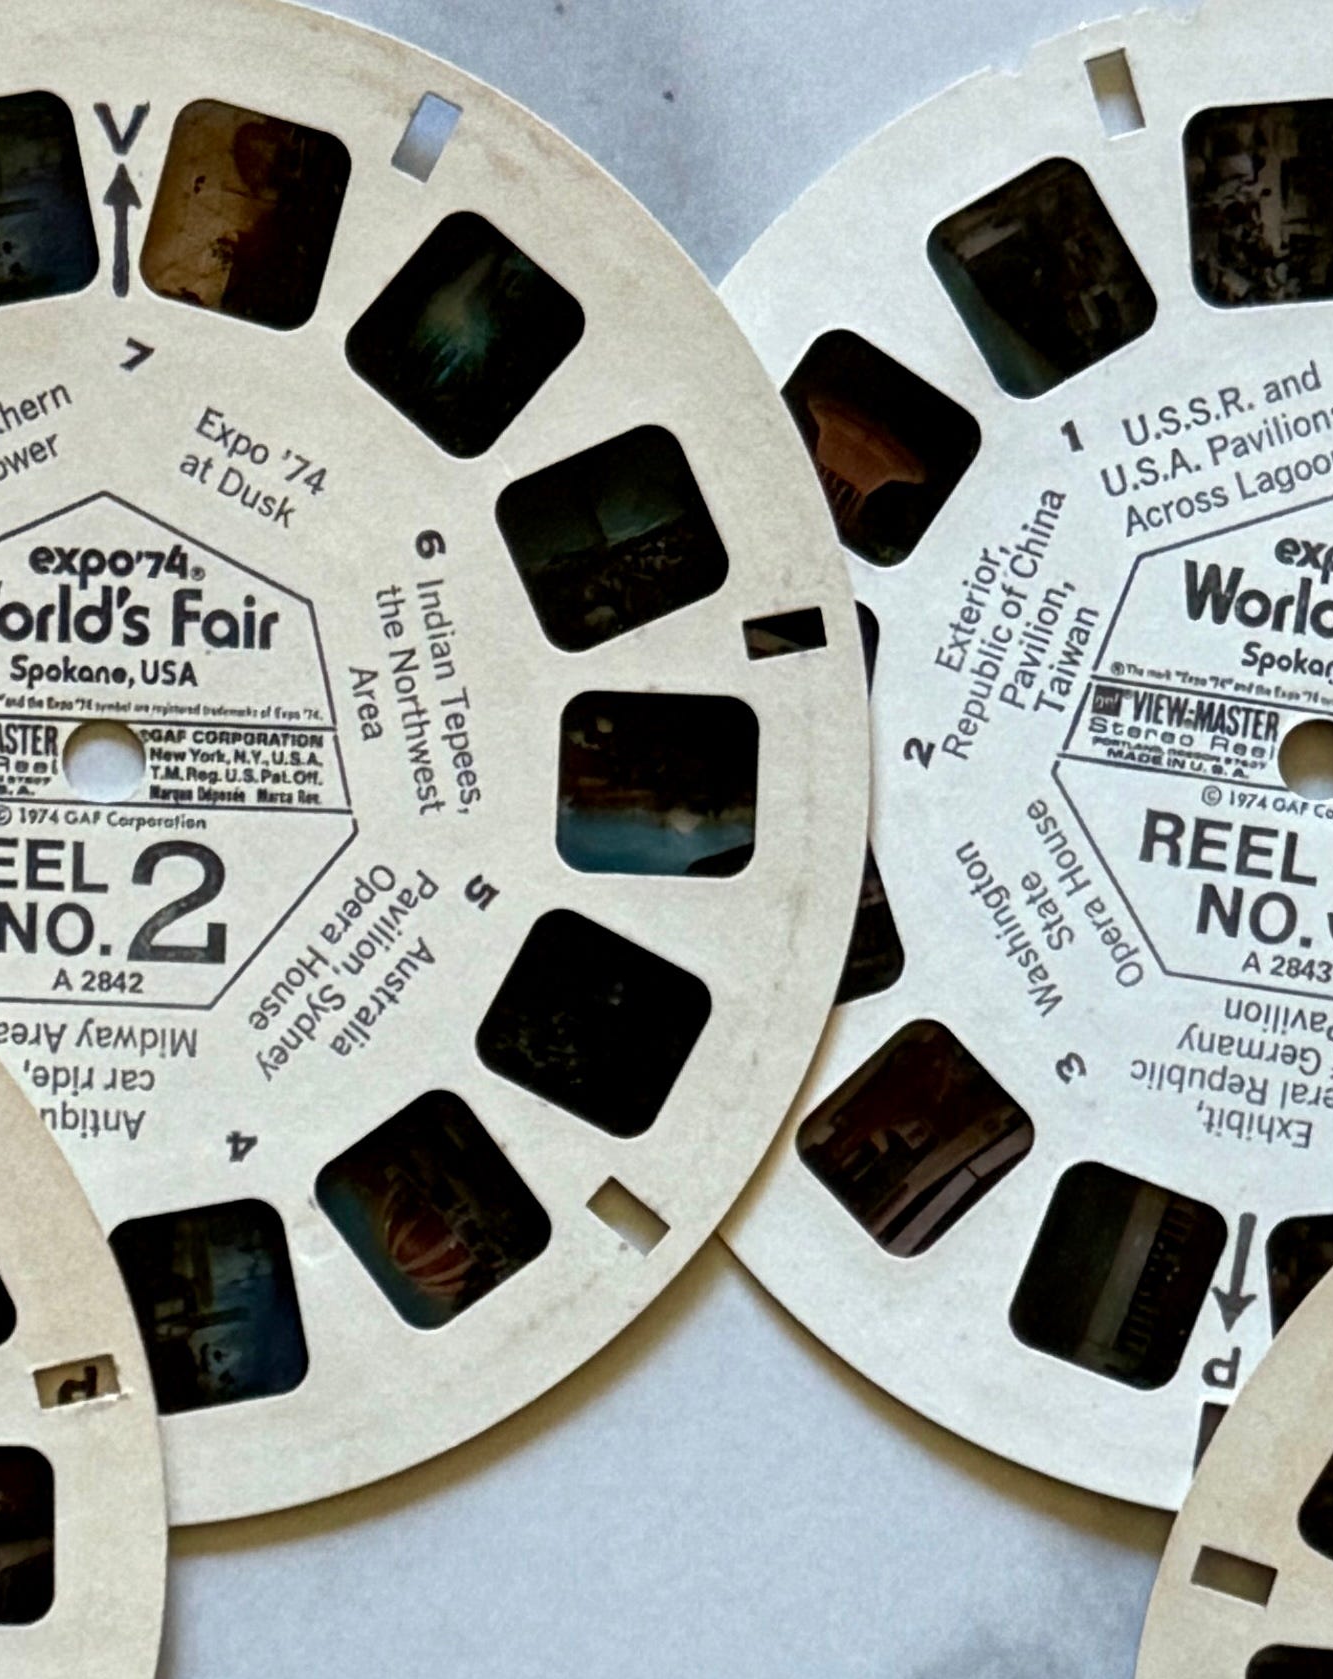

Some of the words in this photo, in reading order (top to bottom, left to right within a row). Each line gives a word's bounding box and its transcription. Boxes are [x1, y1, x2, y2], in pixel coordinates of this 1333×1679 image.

[94, 103, 149, 154] V
[1121, 386, 1254, 446] U.S.S.R.
[1263, 359, 1321, 403] and
[195, 405, 269, 465] Expo
[1060, 419, 1084, 452] 1
[179, 453, 213, 484] at
[216, 466, 295, 528] Dusk
[1100, 447, 1201, 496] U.S.A.
[1125, 485, 1229, 537] Across
[171, 588, 278, 649] Fair
[10, 654, 134, 689] Spokane,
[141, 659, 197, 686] USA
[149, 746, 186, 761] New
[188, 747, 231, 765] York,
[151, 728, 186, 743] GAF
[191, 729, 323, 748] CORPORATION
[19, 806, 59, 824] 1974
[63, 810, 100, 824] GAF
[106, 810, 206, 831] Corporation
[1229, 790, 1266, 809] 1974
[1272, 797, 1308, 815] GAF
[1139, 809, 1316, 886] REEL
[127, 839, 226, 963] 2
[319, 864, 395, 944] Opera
[331, 869, 439, 975] Pavilion,
[1197, 883, 1311, 947] NO.
[53, 968, 71, 989] A
[82, 970, 142, 993] 2842
[248, 944, 329, 1030] House
[1242, 952, 1260, 972] A
[1270, 955, 1332, 982] 2843
[329, 936, 435, 1056] Australia
[74, 1017, 197, 1058] Midway
[255, 983, 346, 1081] Sydney
[23, 1059, 94, 1096] ride,
[103, 1067, 155, 1091] car
[39, 1100, 145, 1140] Antiqu
